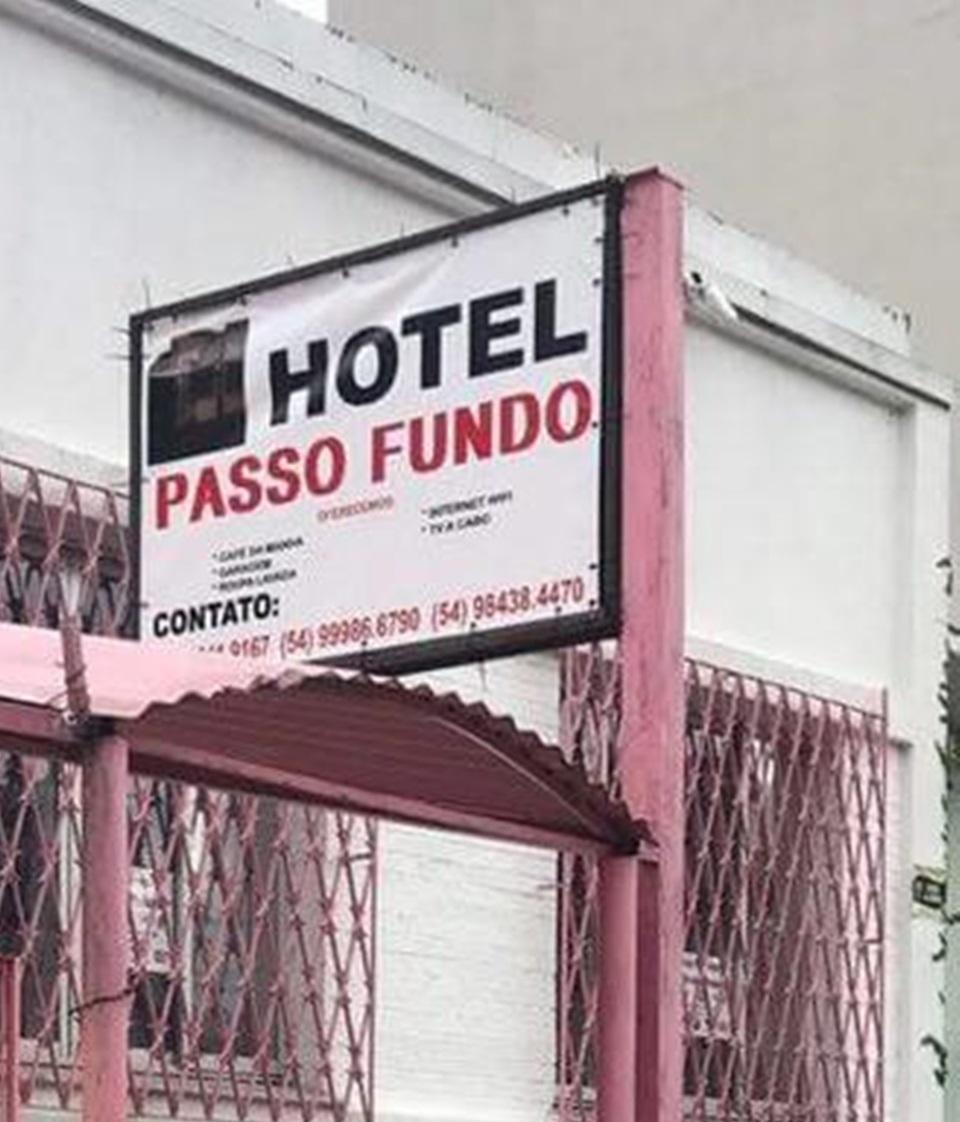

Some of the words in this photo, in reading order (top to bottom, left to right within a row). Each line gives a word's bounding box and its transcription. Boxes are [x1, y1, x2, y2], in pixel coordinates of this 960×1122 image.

[268, 278, 588, 427] HOTEL
[154, 436, 348, 531] PASSO
[370, 378, 594, 484] FUNDO
[428, 497, 486, 519] INTERNET
[153, 593, 280, 638] CONTATO:
[280, 626, 315, 659] (54)
[432, 599, 468, 632] (54)
